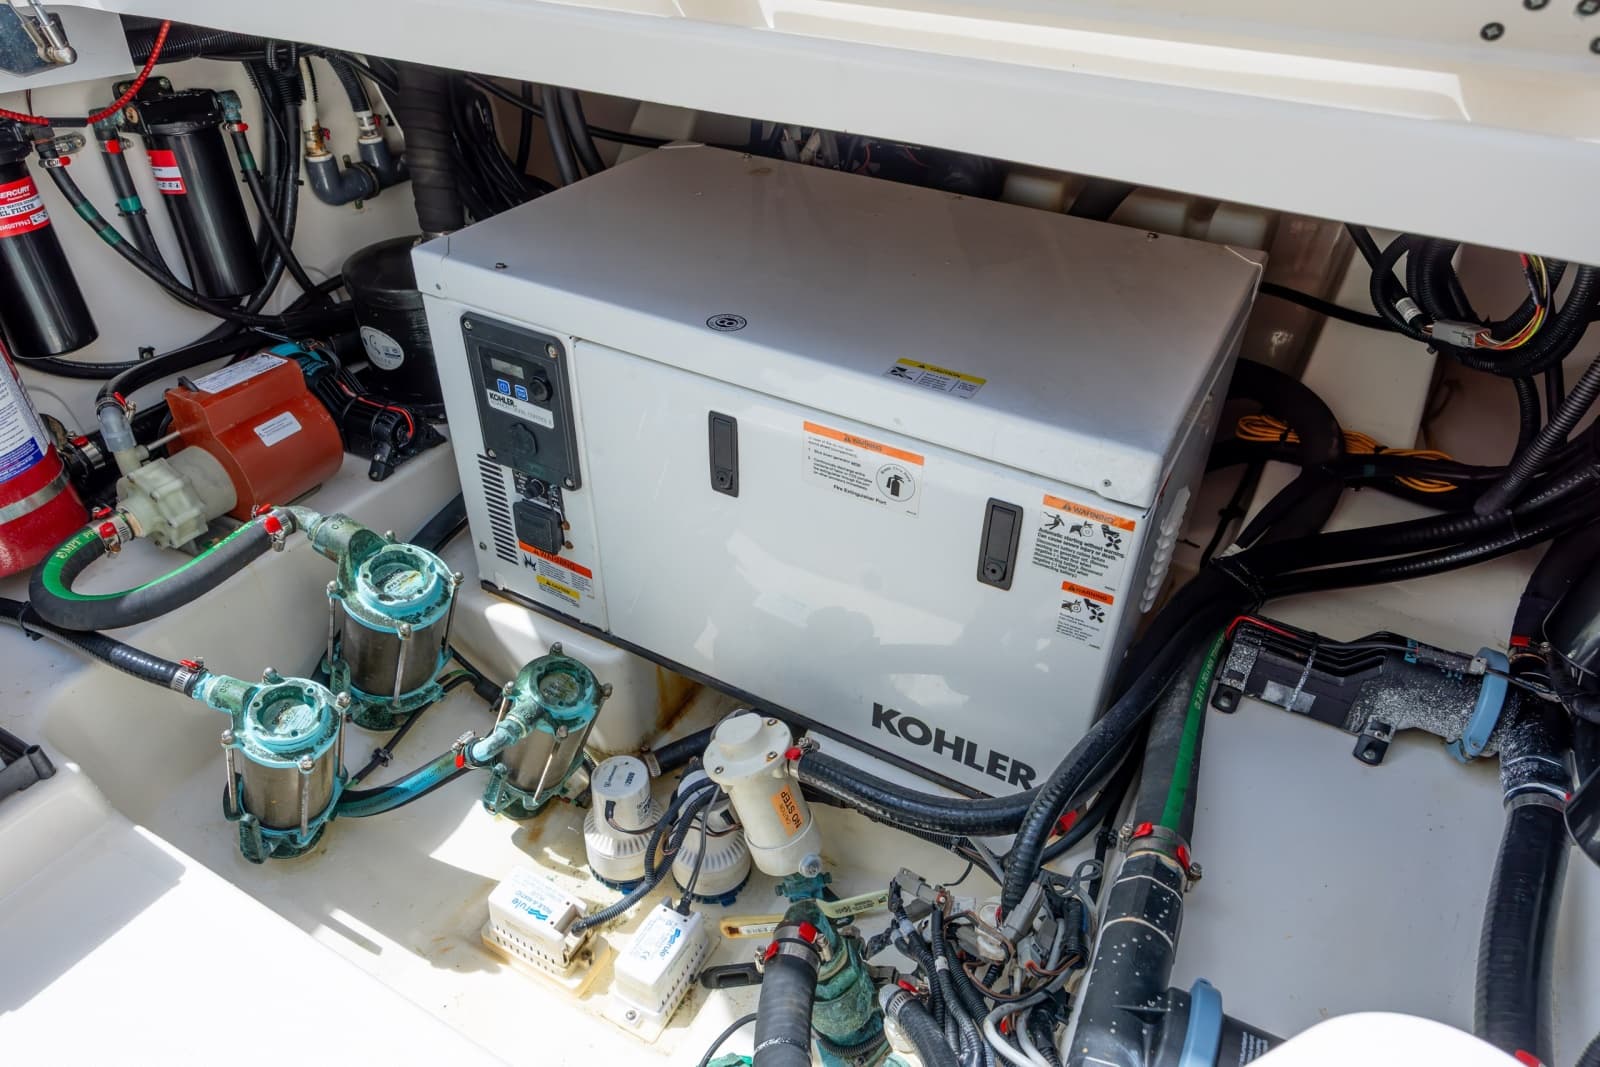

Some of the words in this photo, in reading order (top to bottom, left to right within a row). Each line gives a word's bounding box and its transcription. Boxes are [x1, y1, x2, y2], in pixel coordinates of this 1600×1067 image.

[489, 392, 515, 406] KOHLER
[1074, 507, 1114, 522] WARNING
[872, 702, 1036, 790] KOHLER
[780, 791, 796, 814] STEP
[792, 813, 802, 829] NO
